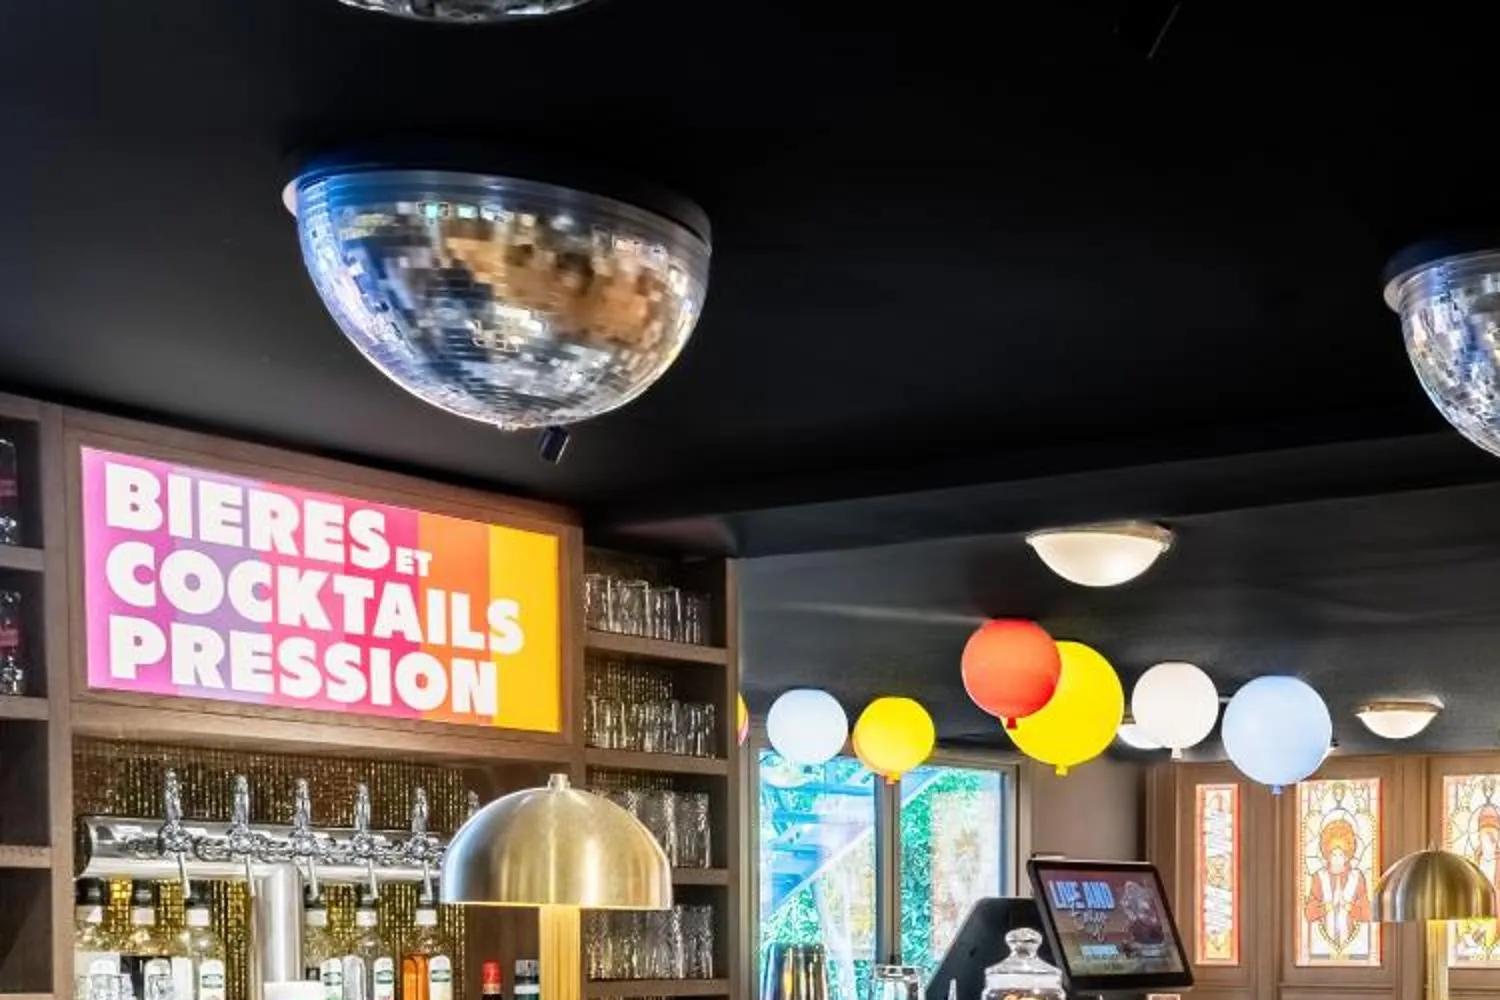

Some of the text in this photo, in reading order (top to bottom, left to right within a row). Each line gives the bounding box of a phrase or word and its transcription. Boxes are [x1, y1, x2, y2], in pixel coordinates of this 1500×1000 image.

[105, 462, 432, 577] BIERES ET
[105, 541, 525, 655] COCKTAILS
[109, 615, 498, 716] PRESSION
